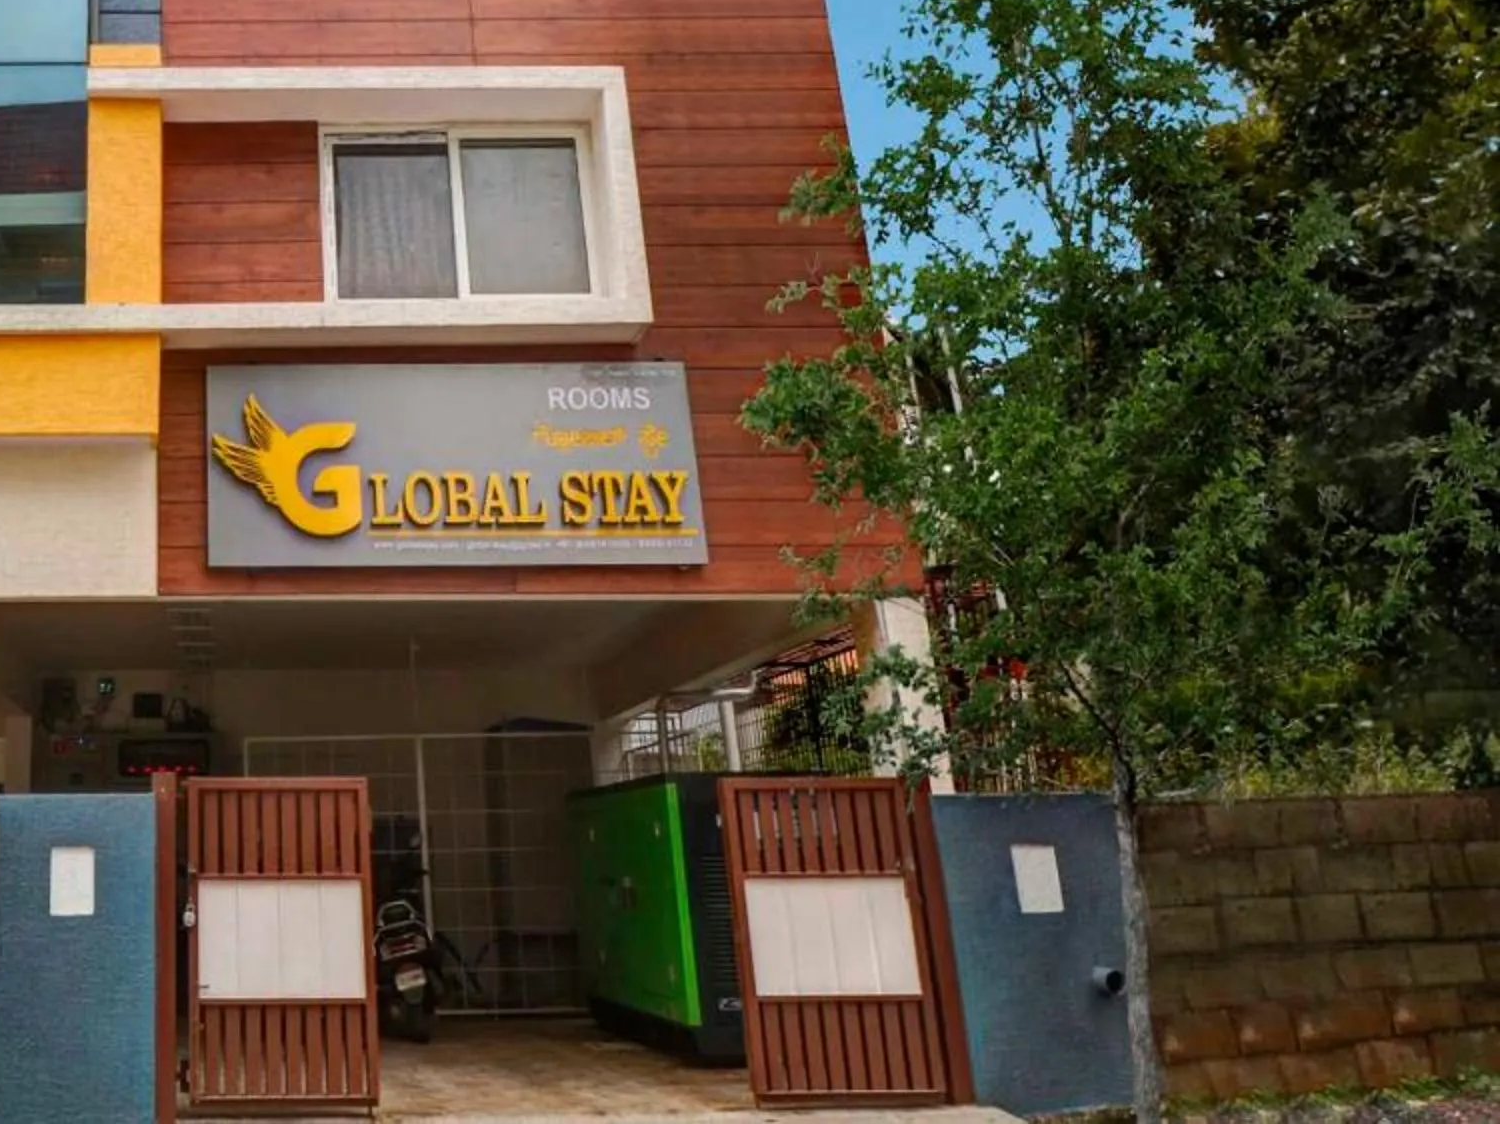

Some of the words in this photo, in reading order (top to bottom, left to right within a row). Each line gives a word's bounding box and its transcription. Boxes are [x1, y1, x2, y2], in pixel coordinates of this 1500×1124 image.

[548, 386, 651, 410] ROOMS
[256, 420, 549, 537] GLOBAL
[560, 471, 689, 527] STAY
